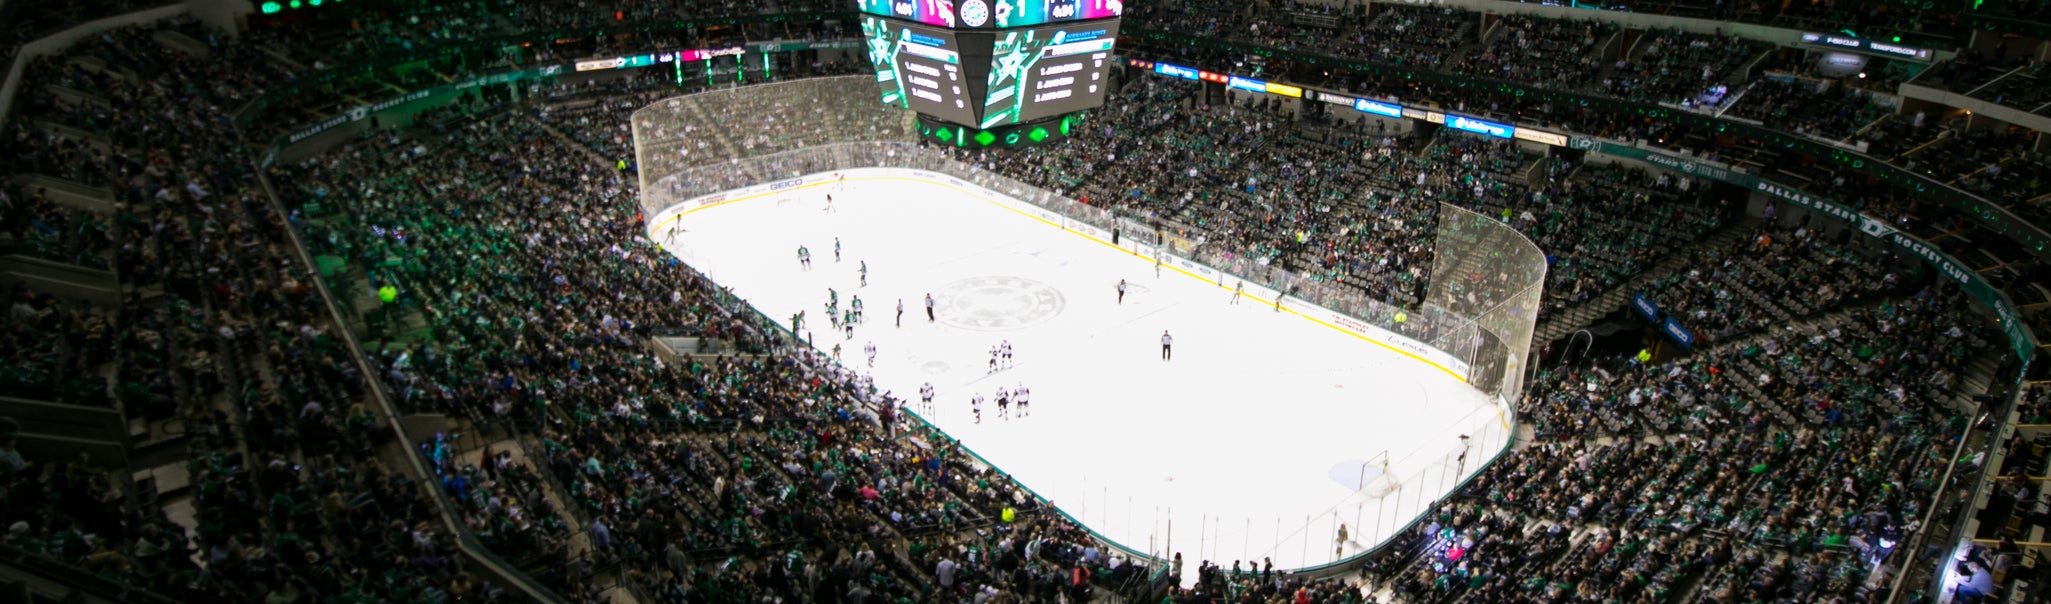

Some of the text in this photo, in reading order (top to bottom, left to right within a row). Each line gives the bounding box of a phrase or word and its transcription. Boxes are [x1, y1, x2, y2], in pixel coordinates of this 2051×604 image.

[1646, 154, 1679, 167] STARS
[769, 179, 804, 191] GEICO
[1757, 182, 1970, 285] DALLAS STARS HOCKEY CLUB
[1667, 322, 1689, 343] GEICO
